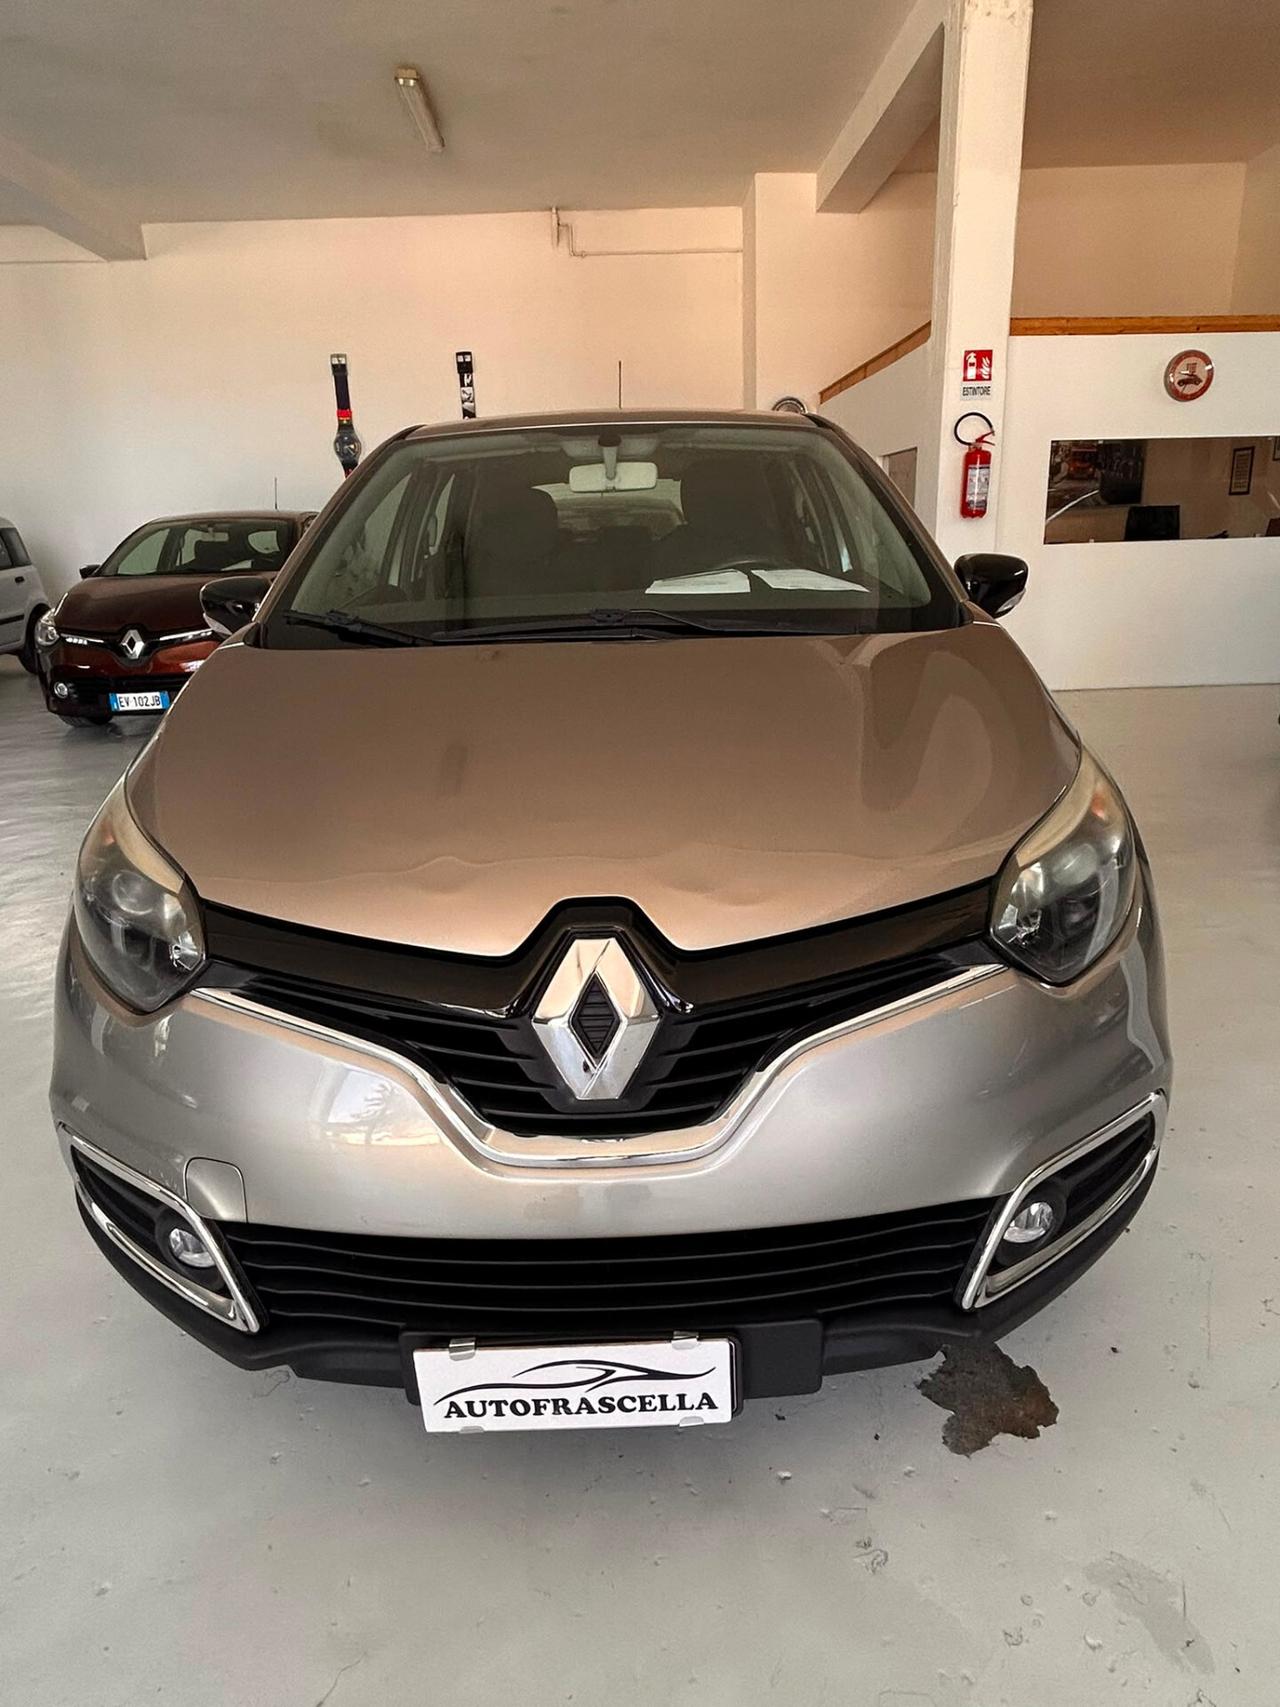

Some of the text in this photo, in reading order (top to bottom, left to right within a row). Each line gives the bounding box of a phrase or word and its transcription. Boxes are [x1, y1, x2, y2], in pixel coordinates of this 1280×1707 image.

[962, 385, 991, 397] ESTINTORE
[118, 696, 130, 708] EV
[444, 1392, 718, 1419] AUTOFRASCELLA
